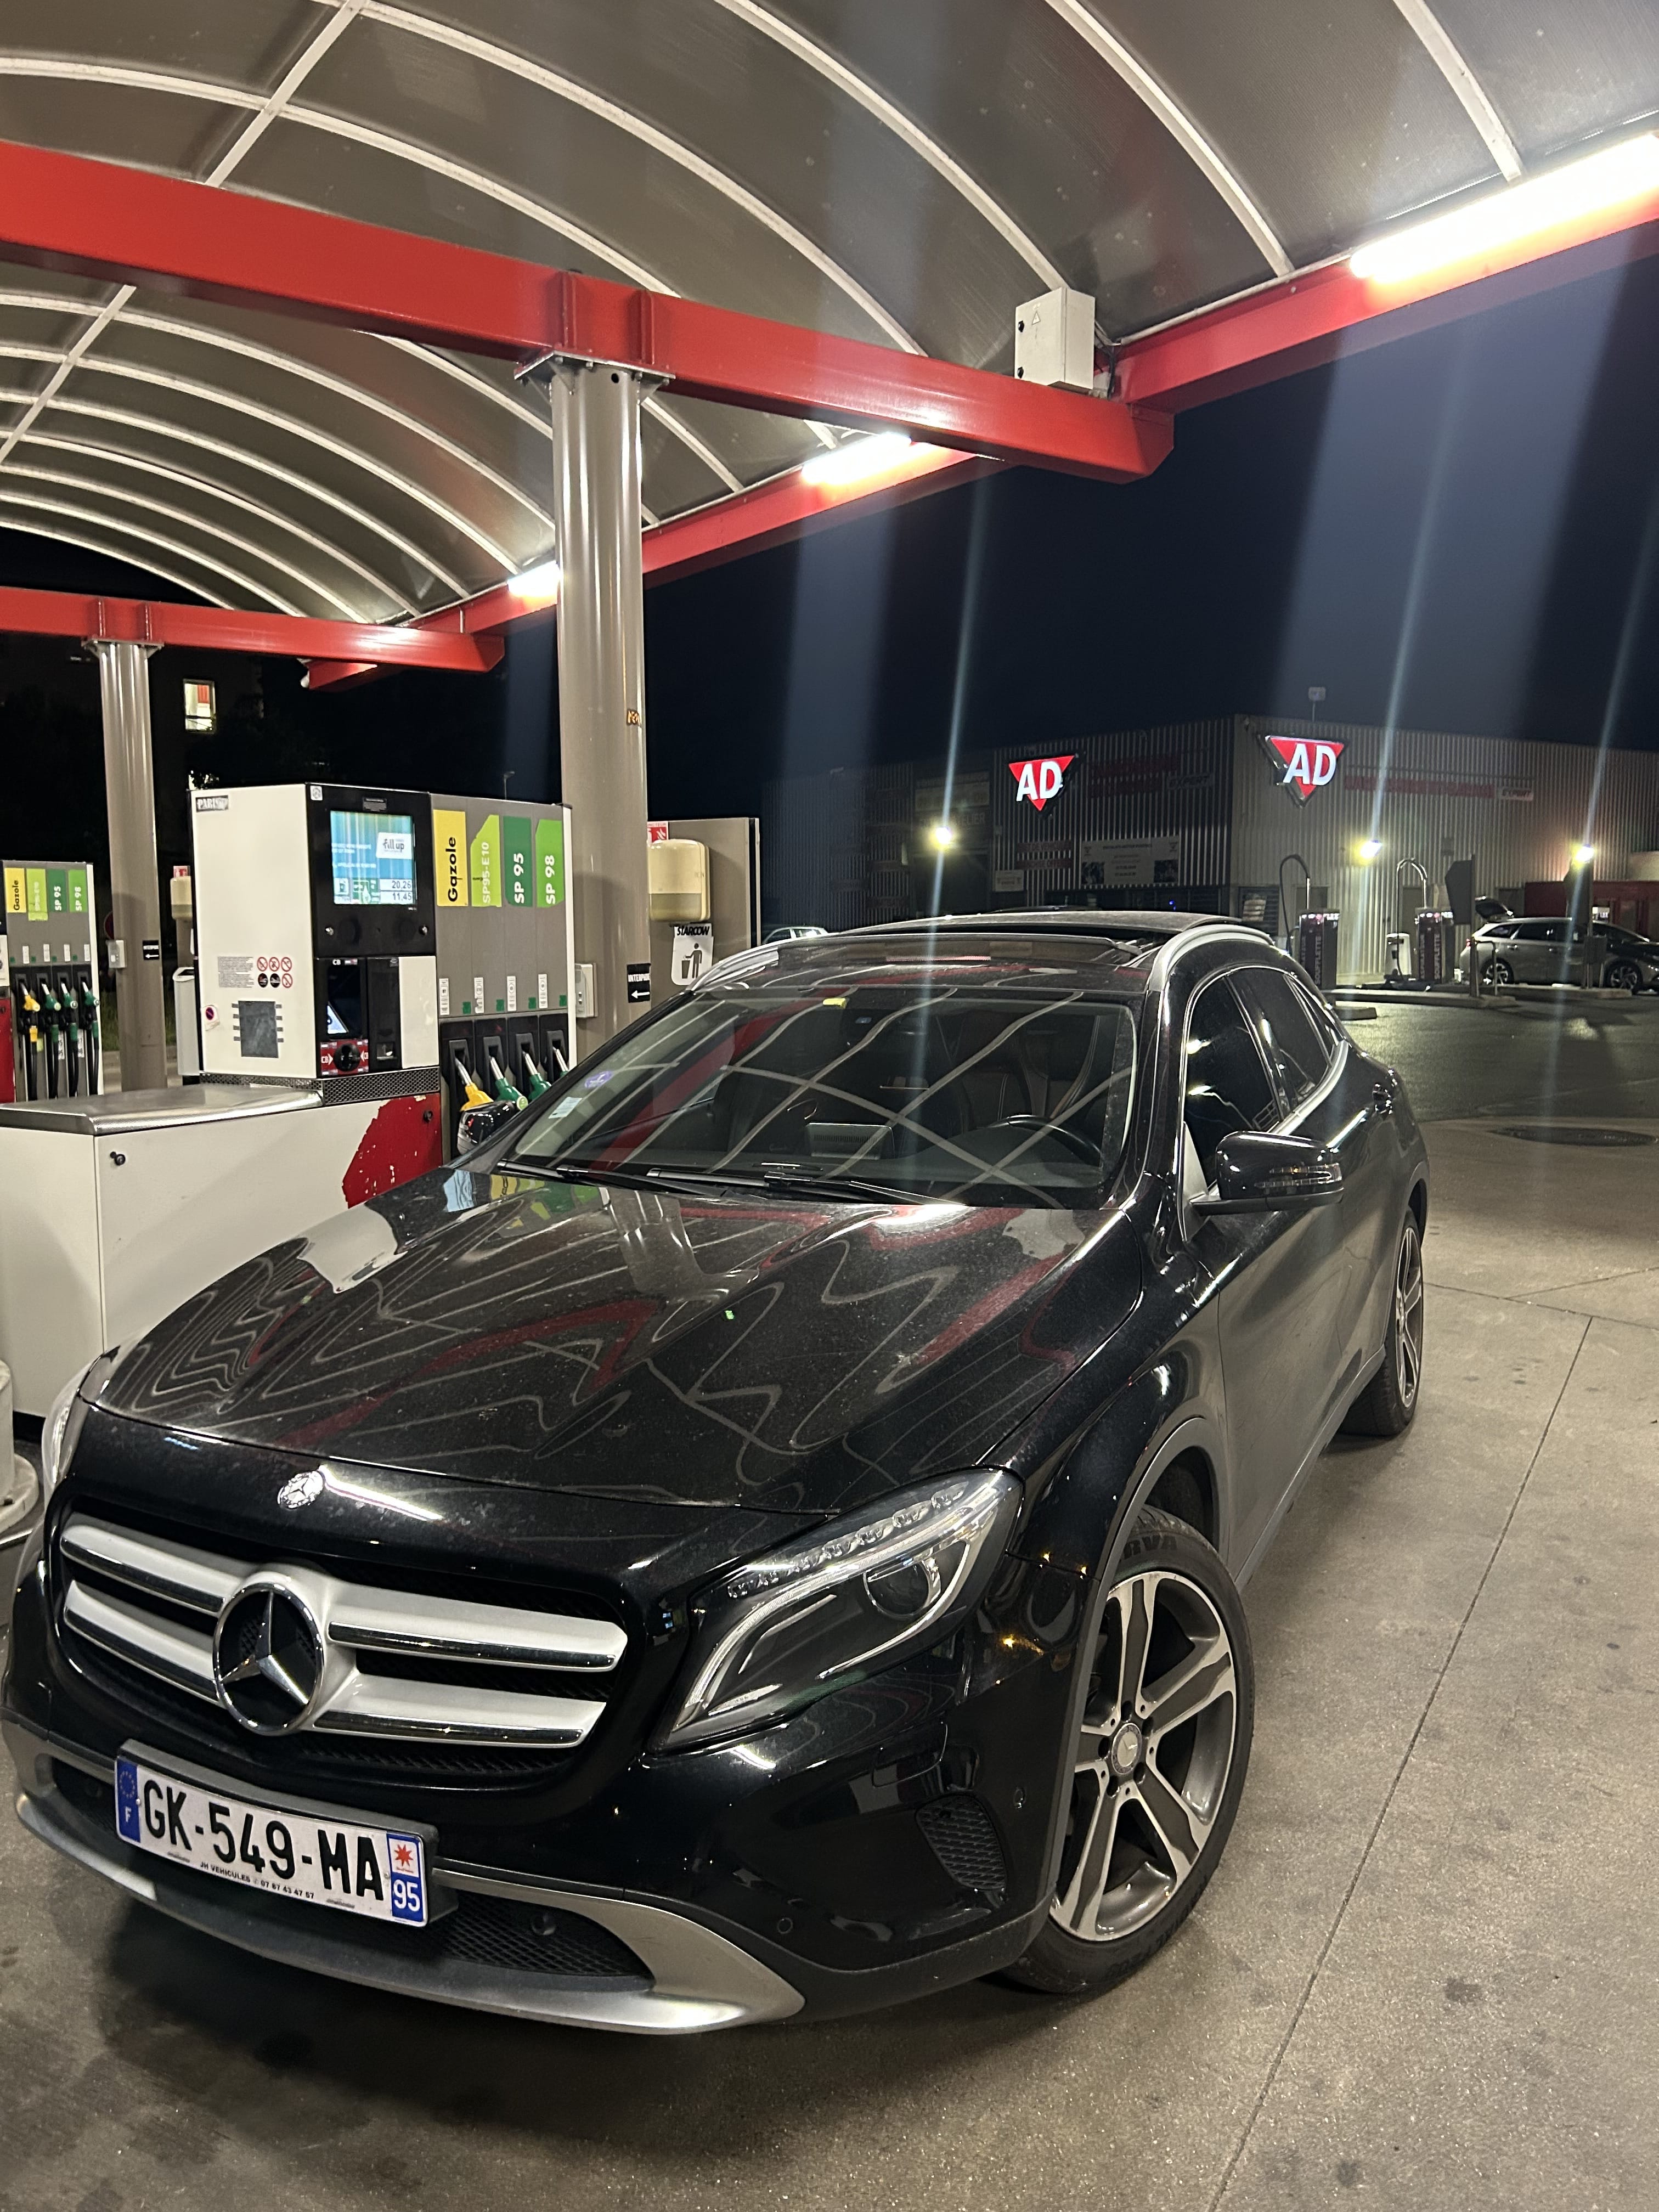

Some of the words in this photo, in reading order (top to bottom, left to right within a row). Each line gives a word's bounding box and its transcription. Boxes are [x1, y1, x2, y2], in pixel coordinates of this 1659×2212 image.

[1283, 743, 1336, 786] AD
[1016, 760, 1062, 801] AD
[396, 843, 405, 853] up
[445, 837, 458, 902] Gazole
[481, 842, 491, 904] SP95-E10
[514, 853, 524, 877] 95
[545, 855, 555, 878] 98
[12, 880, 20, 911] Gazole
[54, 886, 61, 898] 95
[75, 887, 82, 899] 98
[514, 881, 524, 904] SP
[546, 883, 556, 905] SP
[55, 900, 62, 911] SP
[76, 900, 82, 911] SP
[125, 1806, 132, 1823] F
[144, 1780, 384, 1901] GK-549-MA
[200, 1861, 208, 1870] JH
[211, 1864, 251, 1883] VEHICULES
[393, 1879, 420, 1912] 95
